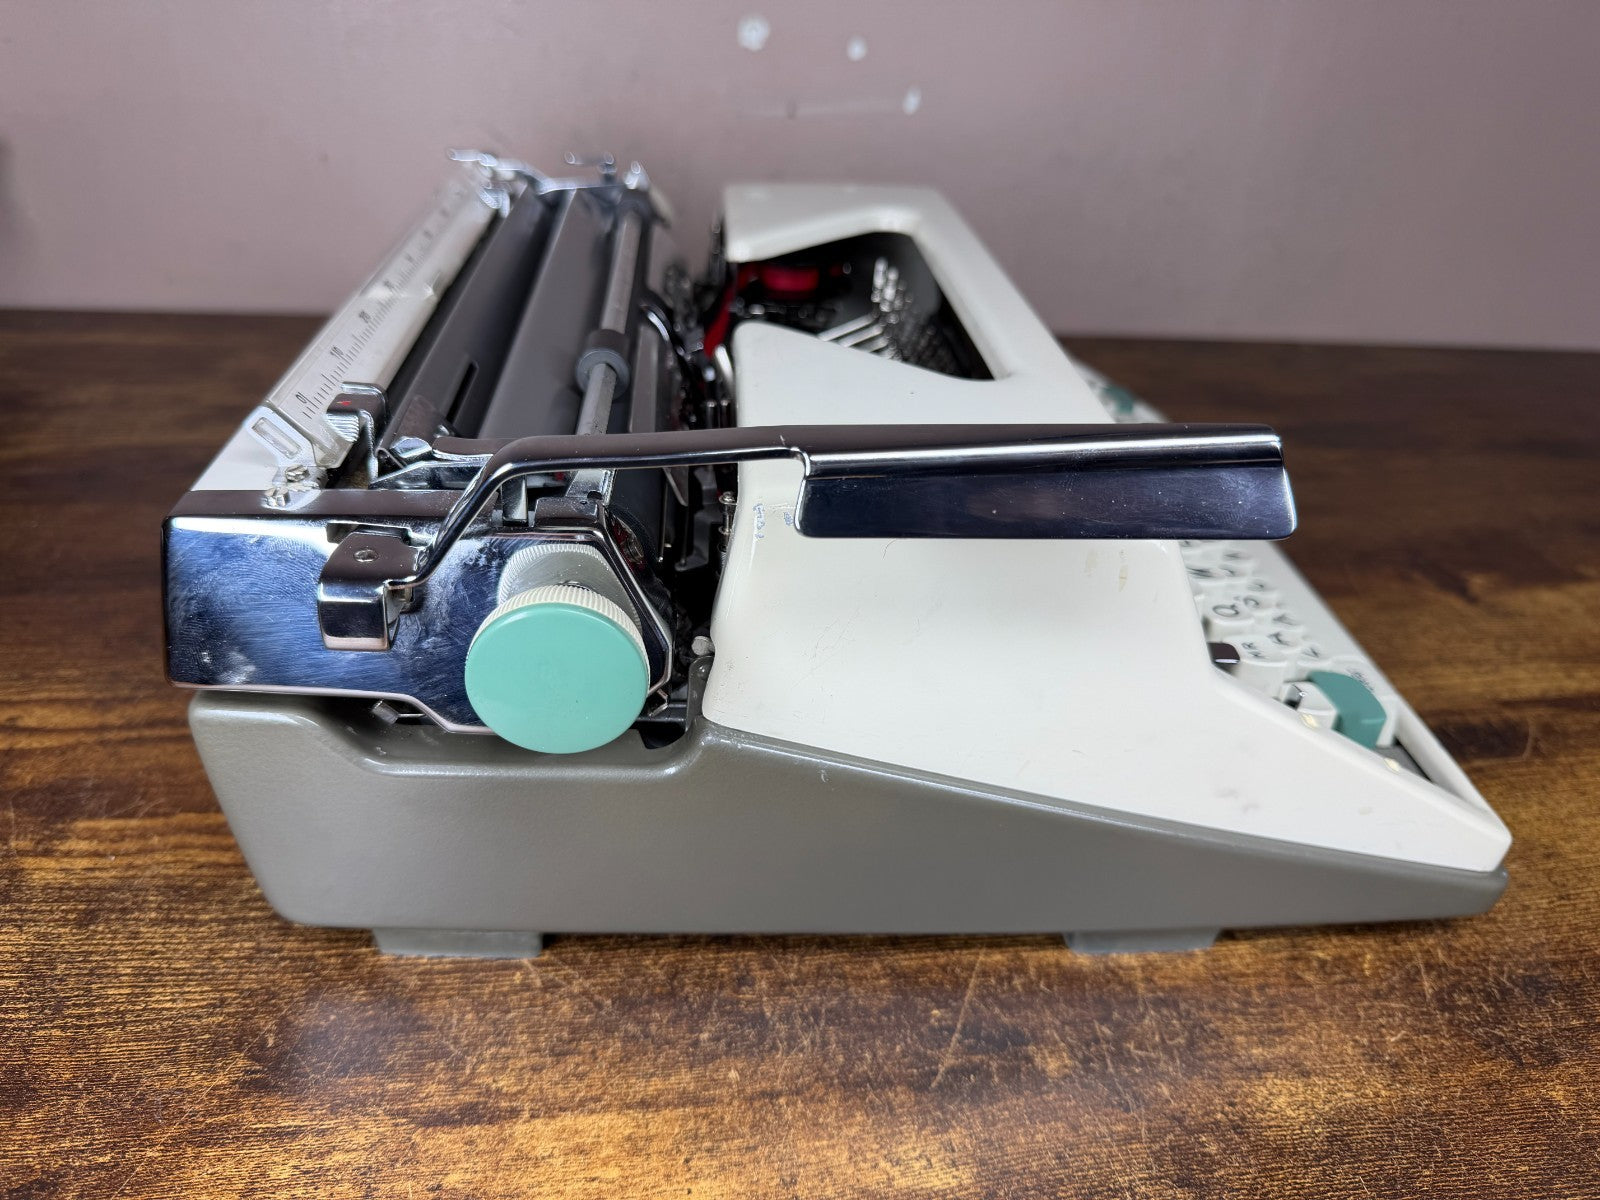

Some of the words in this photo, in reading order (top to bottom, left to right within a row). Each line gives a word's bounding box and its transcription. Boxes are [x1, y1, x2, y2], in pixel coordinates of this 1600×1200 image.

[330, 346, 344, 359] 10
[295, 393, 307, 404] 0
[1212, 604, 1240, 617] Q
